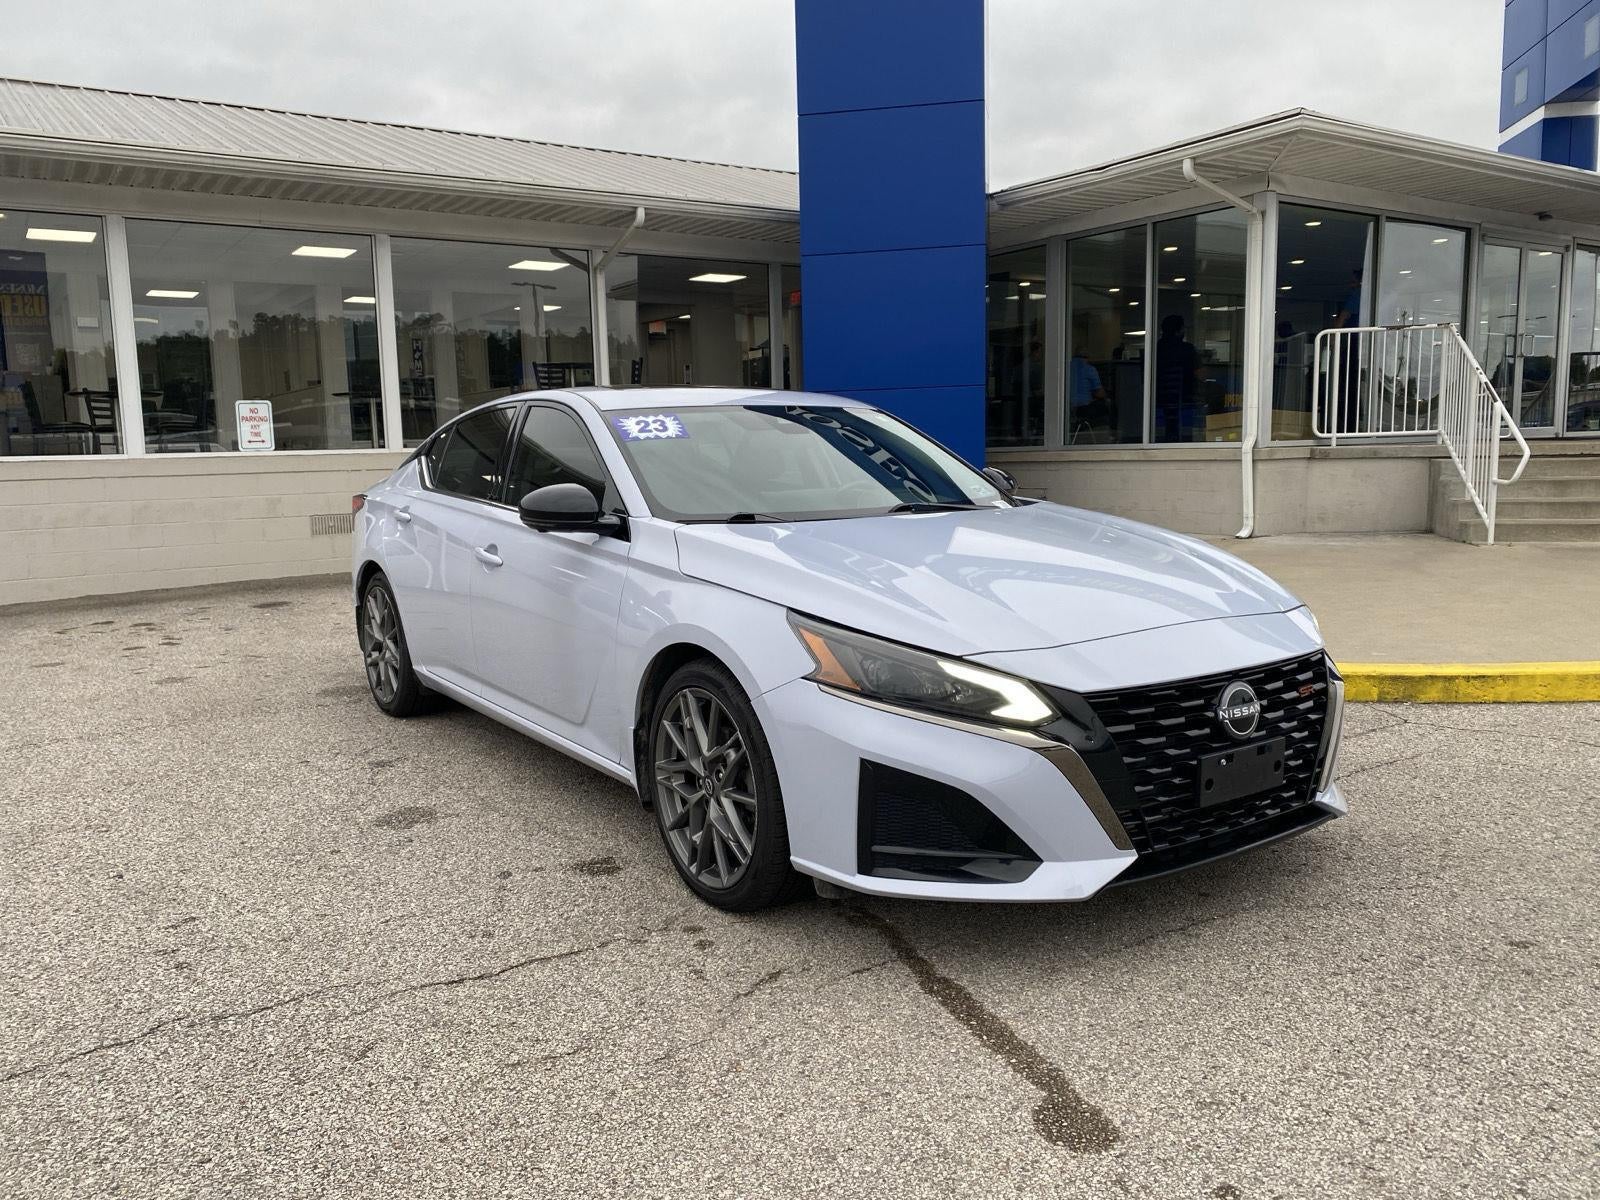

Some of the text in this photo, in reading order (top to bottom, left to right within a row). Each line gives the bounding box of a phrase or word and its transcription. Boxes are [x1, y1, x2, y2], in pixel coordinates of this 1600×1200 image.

[249, 407, 259, 415] NO
[240, 415, 268, 423] PARKING
[635, 418, 669, 434] 23
[1299, 684, 1315, 697] SR
[1219, 702, 1260, 720] NISSAN
